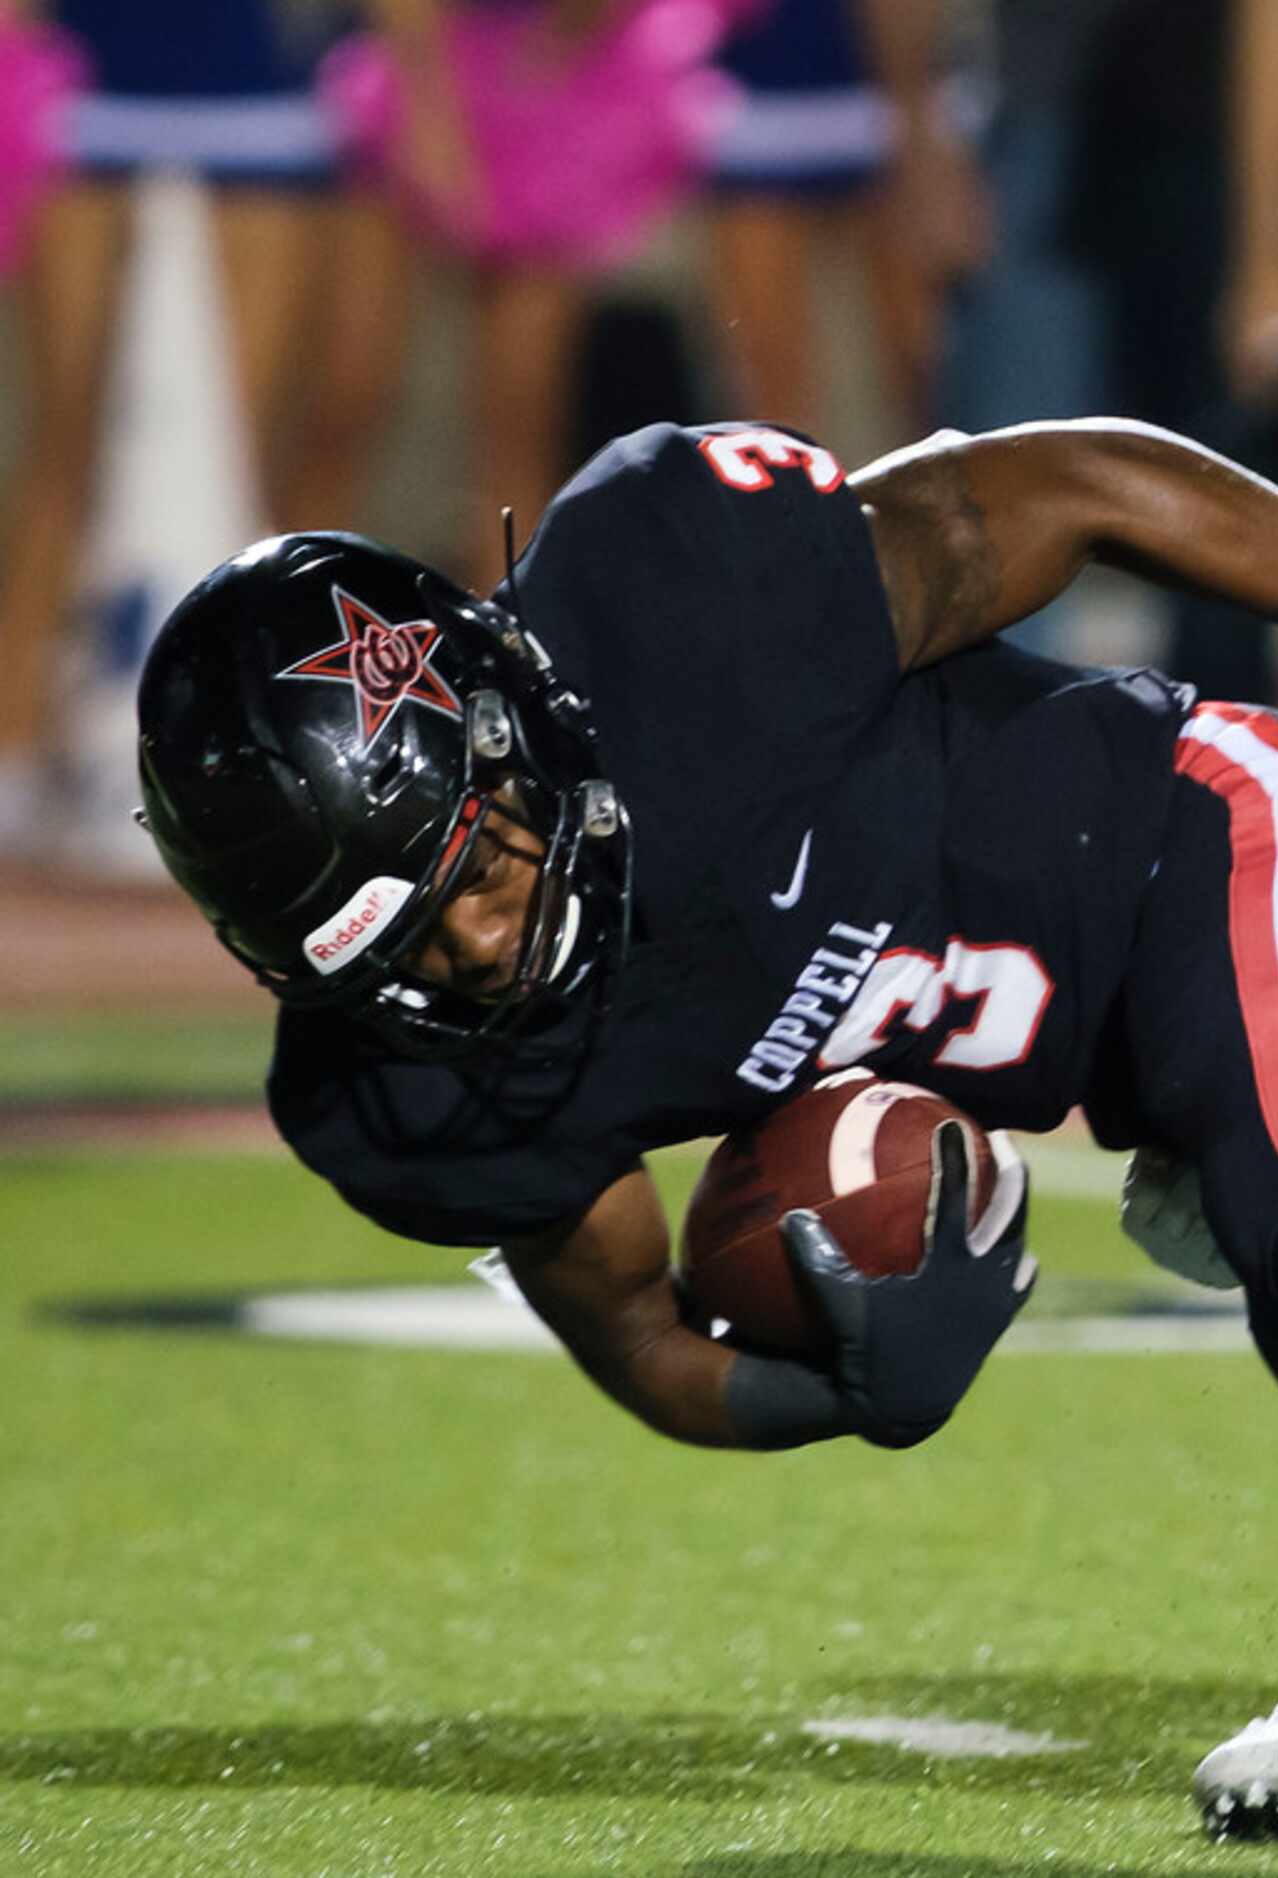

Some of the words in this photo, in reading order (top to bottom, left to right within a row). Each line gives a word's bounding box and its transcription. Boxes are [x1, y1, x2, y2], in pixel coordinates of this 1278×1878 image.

[697, 431, 847, 494] 3
[736, 921, 893, 1093] COPPELL
[816, 934, 1056, 1071] 3
